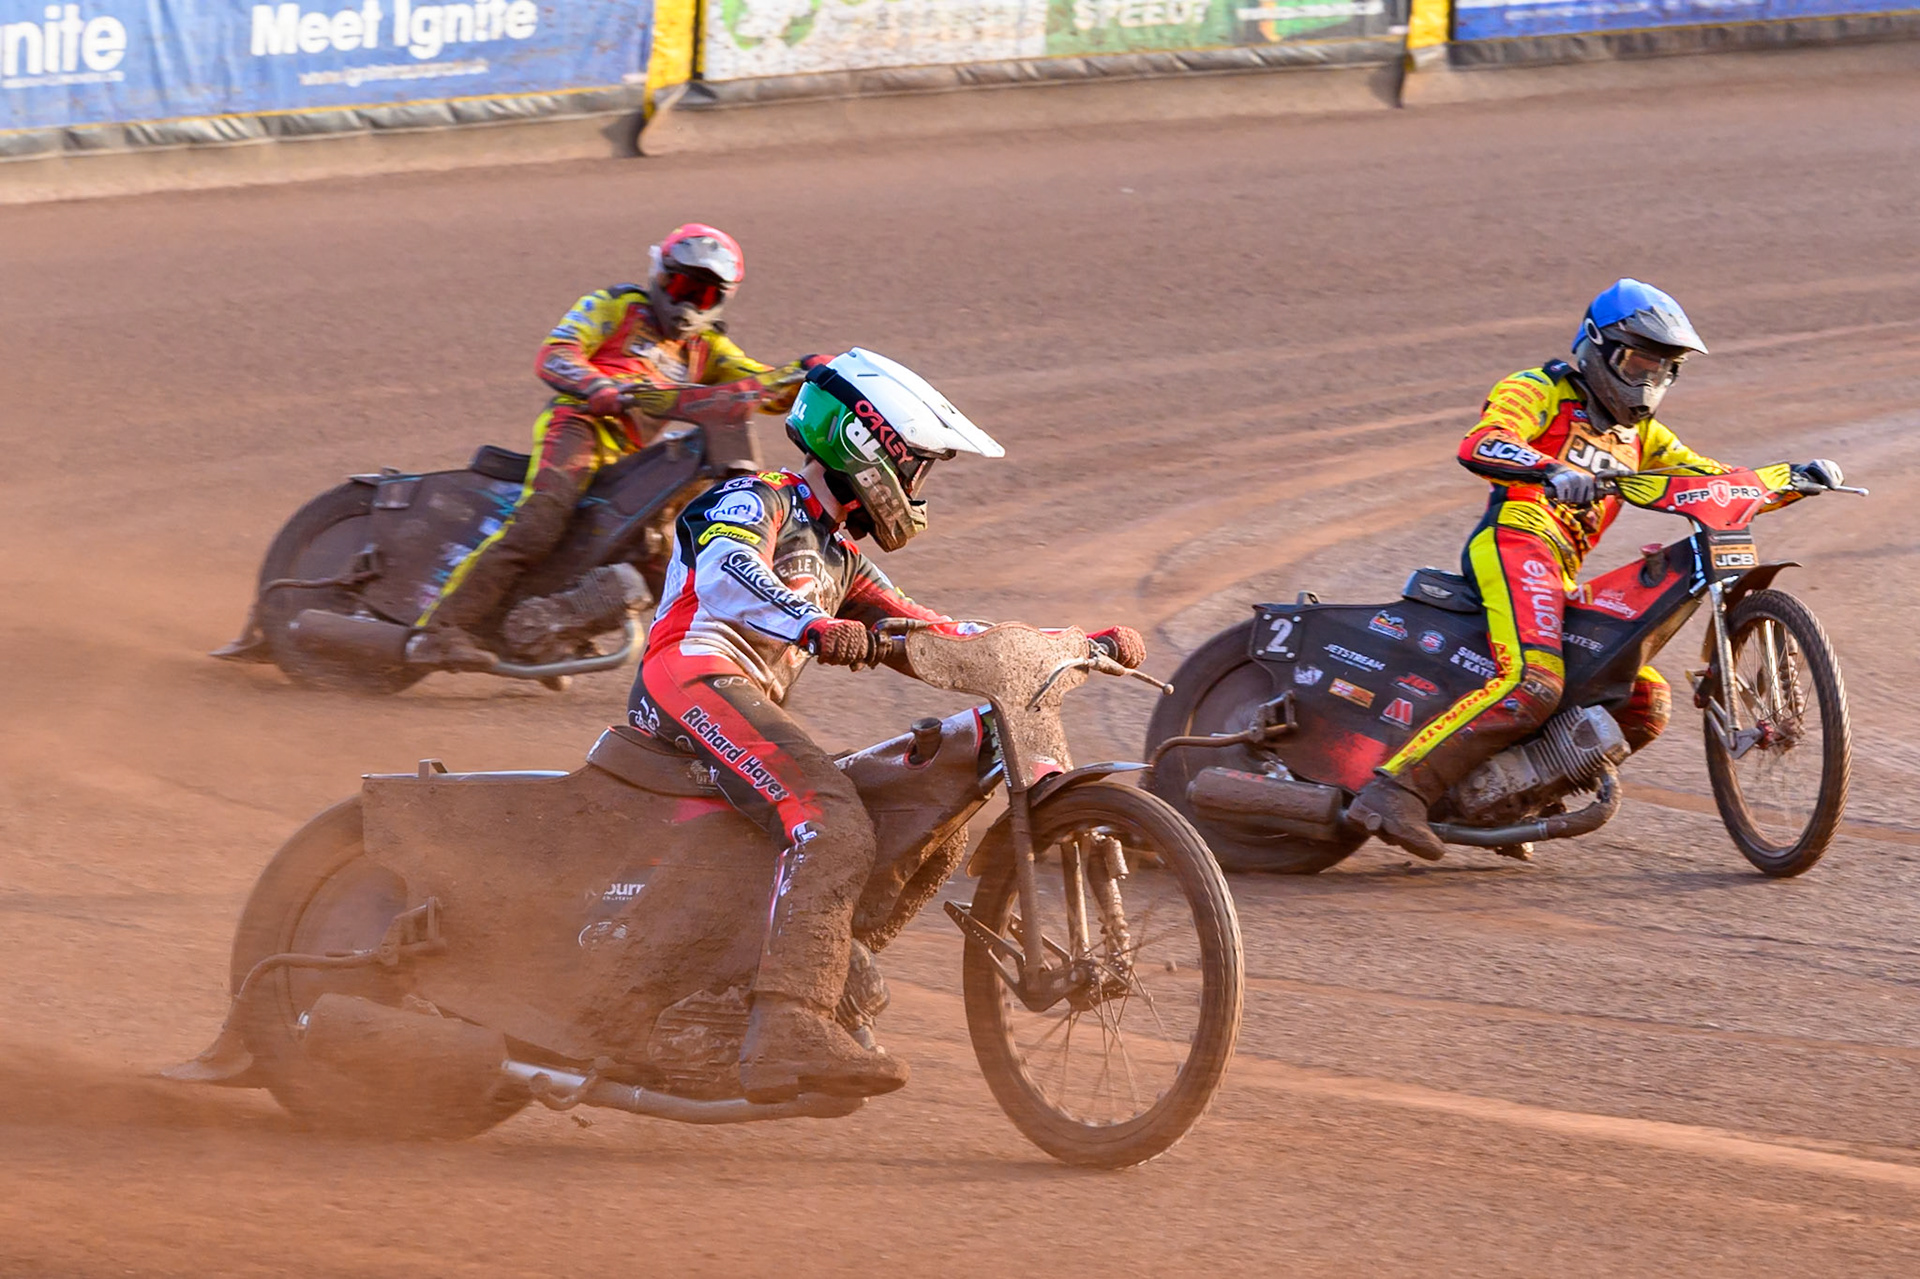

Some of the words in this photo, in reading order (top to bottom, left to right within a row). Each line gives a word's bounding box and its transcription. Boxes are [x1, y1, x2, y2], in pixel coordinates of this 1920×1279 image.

[251, 0, 382, 56] Meet
[394, 0, 537, 59] Ignite
[855, 400, 914, 464] OAKLEY
[1479, 440, 1541, 467] JCB
[1675, 490, 1710, 504] PFP
[1730, 487, 1761, 498] PRO
[1715, 553, 1755, 566] JCB
[1266, 618, 1293, 653] 2
[1450, 655, 1461, 665] &
[1463, 659, 1497, 680] KATE
[681, 705, 748, 764] Richard
[738, 754, 789, 801] Hayes
